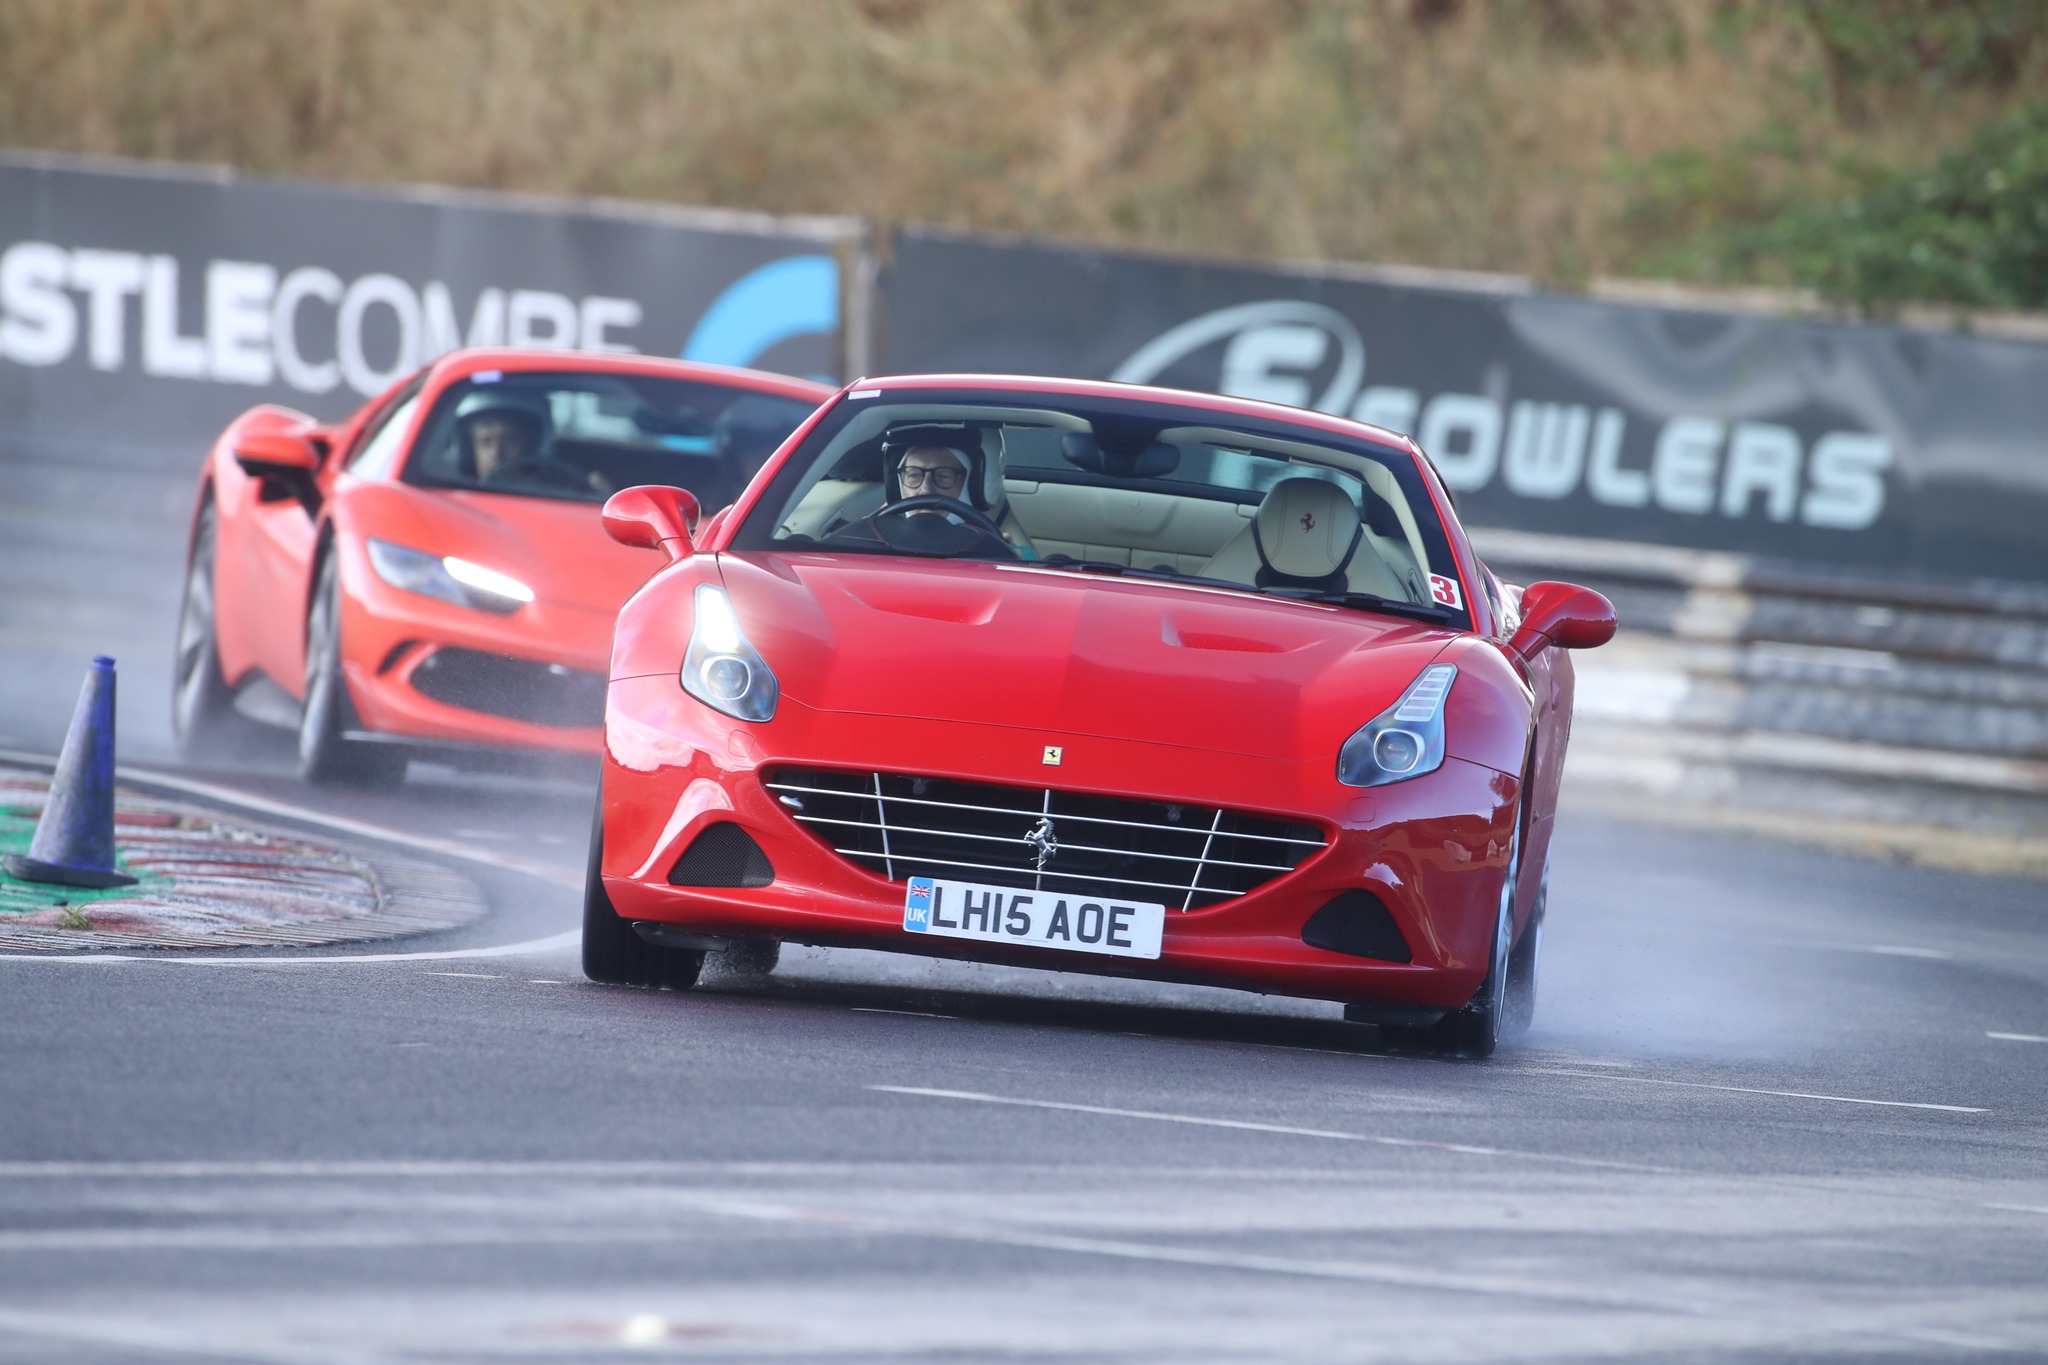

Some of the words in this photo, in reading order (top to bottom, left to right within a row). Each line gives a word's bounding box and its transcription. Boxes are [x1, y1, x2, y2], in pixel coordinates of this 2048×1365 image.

[1430, 575, 1456, 605] 3
[907, 907, 928, 923] UK
[931, 886, 1034, 936] LH15
[1046, 900, 1136, 948] AOE
